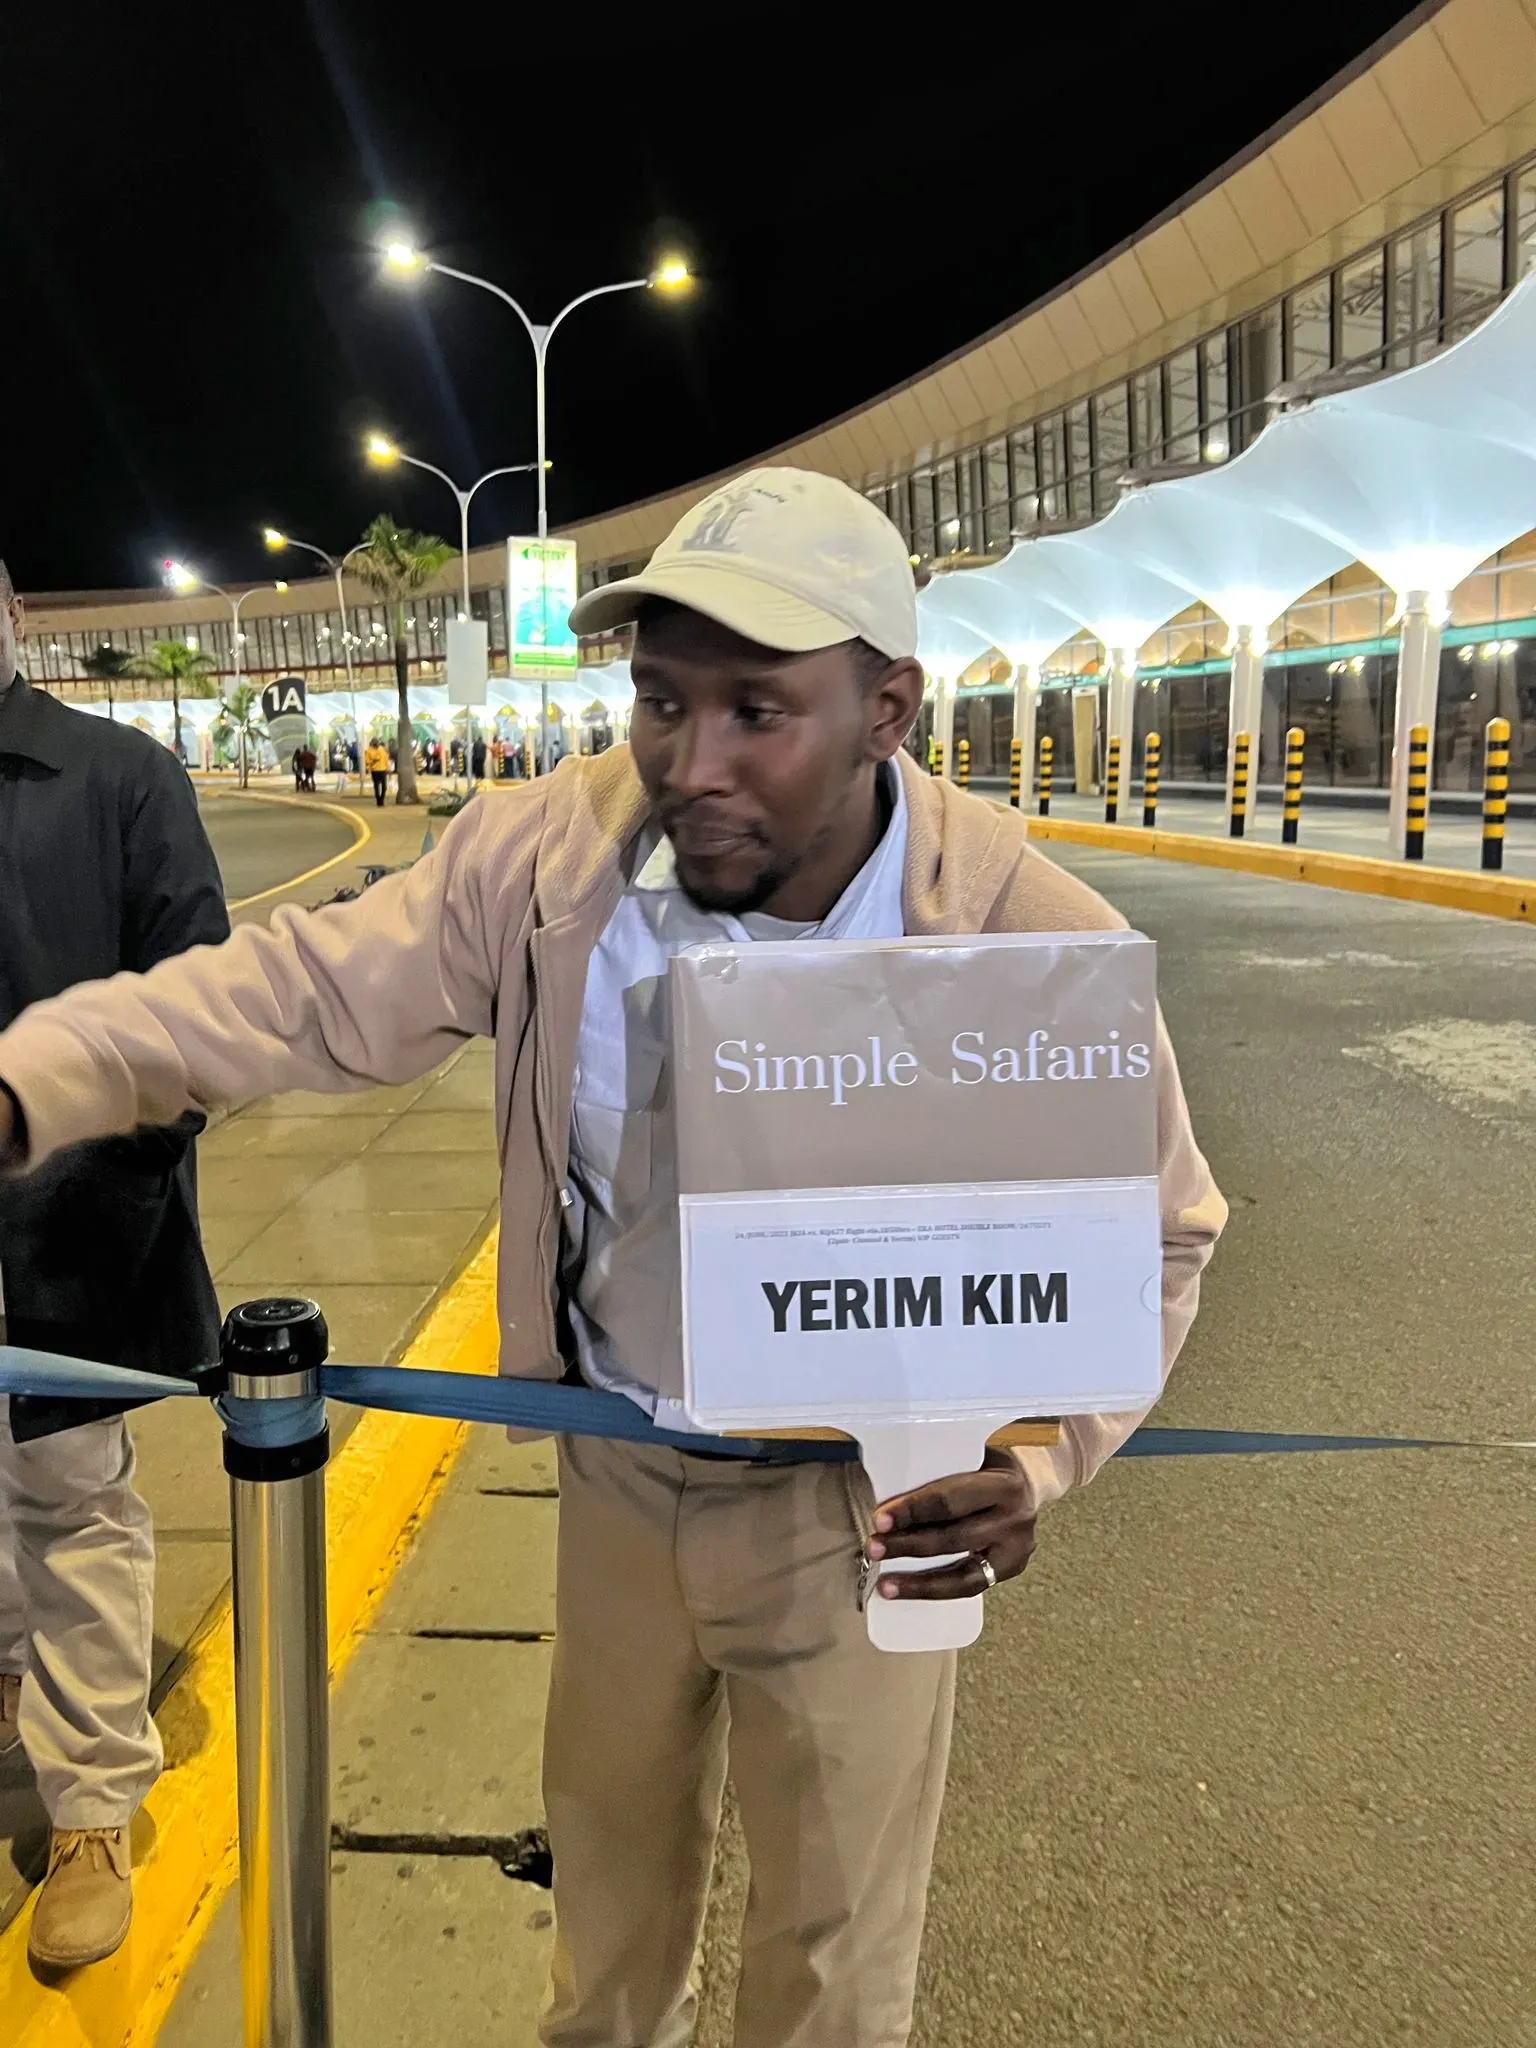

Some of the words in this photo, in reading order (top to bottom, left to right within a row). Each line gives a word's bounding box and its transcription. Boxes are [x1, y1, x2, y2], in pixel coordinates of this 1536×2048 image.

[267, 685, 304, 712] 1A
[714, 1036, 919, 1106] Simple
[951, 1029, 1151, 1085] Safaris
[760, 1275, 942, 1333] YERIM
[961, 1272, 1068, 1326] KIM
